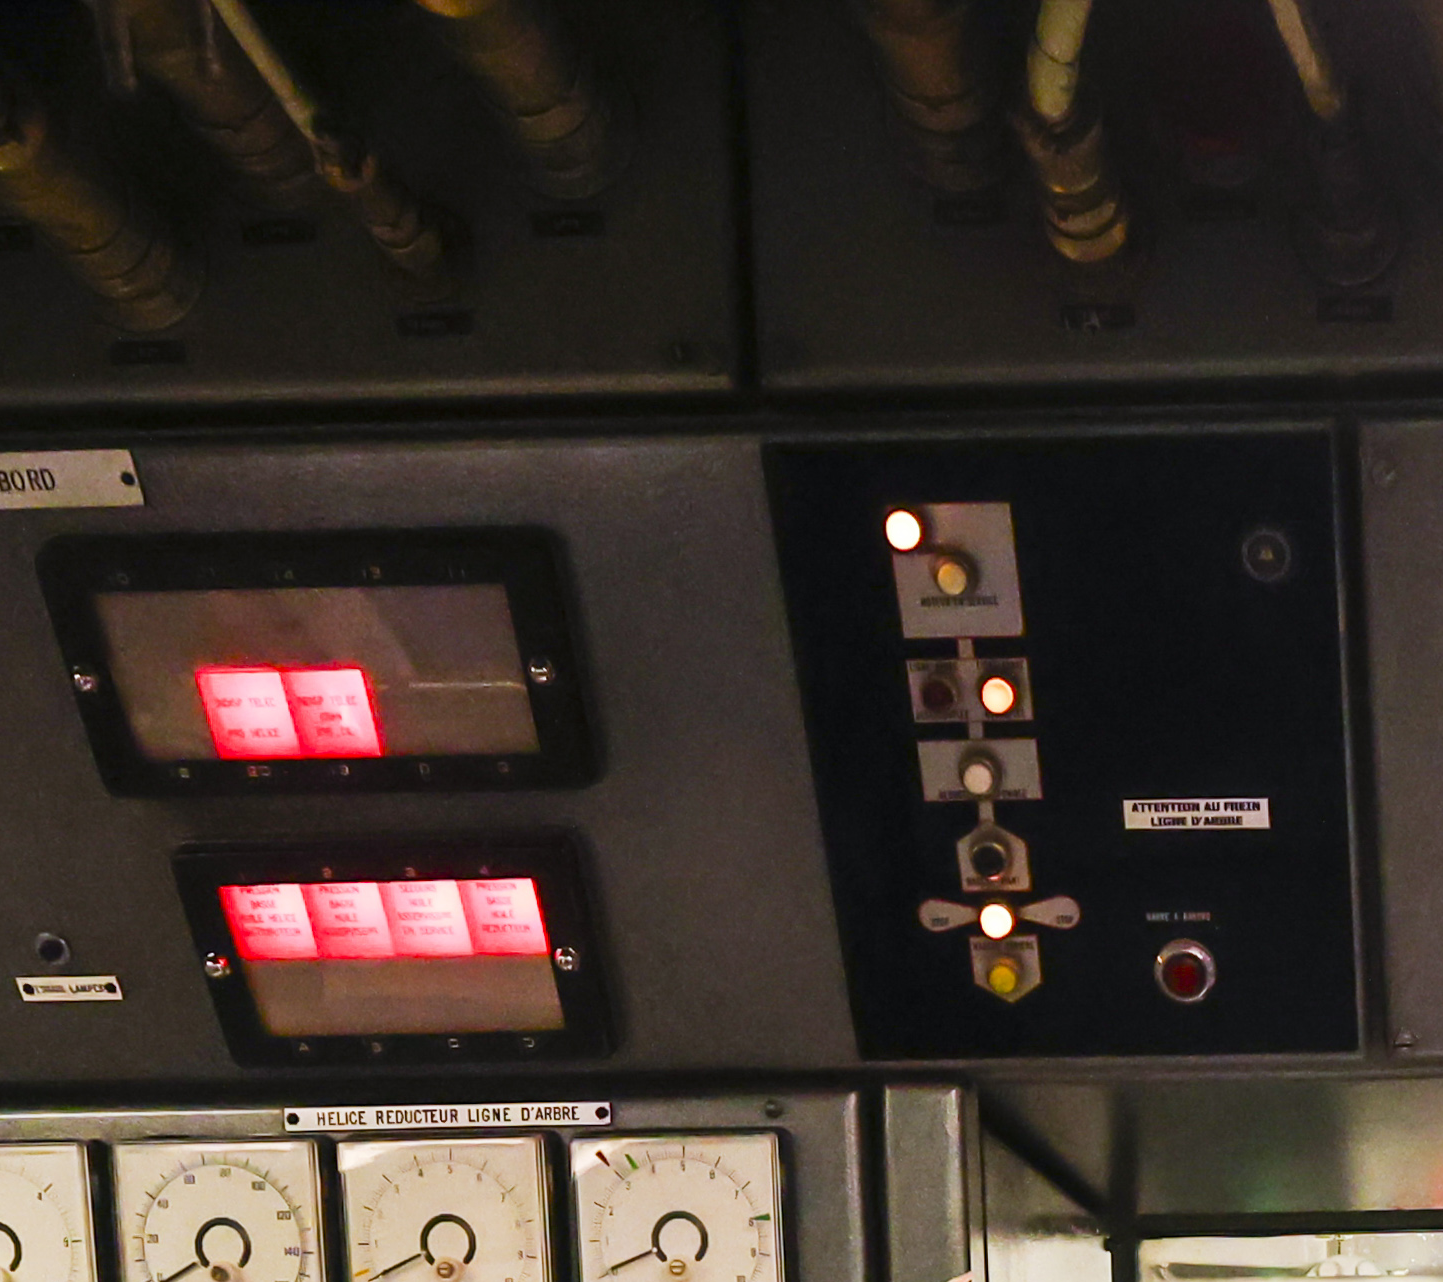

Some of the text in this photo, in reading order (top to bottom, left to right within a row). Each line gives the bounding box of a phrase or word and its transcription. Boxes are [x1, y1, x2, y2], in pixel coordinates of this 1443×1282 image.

[1131, 801, 1200, 814] ATTENTION
[1204, 801, 1221, 813] AU
[316, 1105, 581, 1126] HELICE REDUCTEUR LIGNE D'ARBRE
